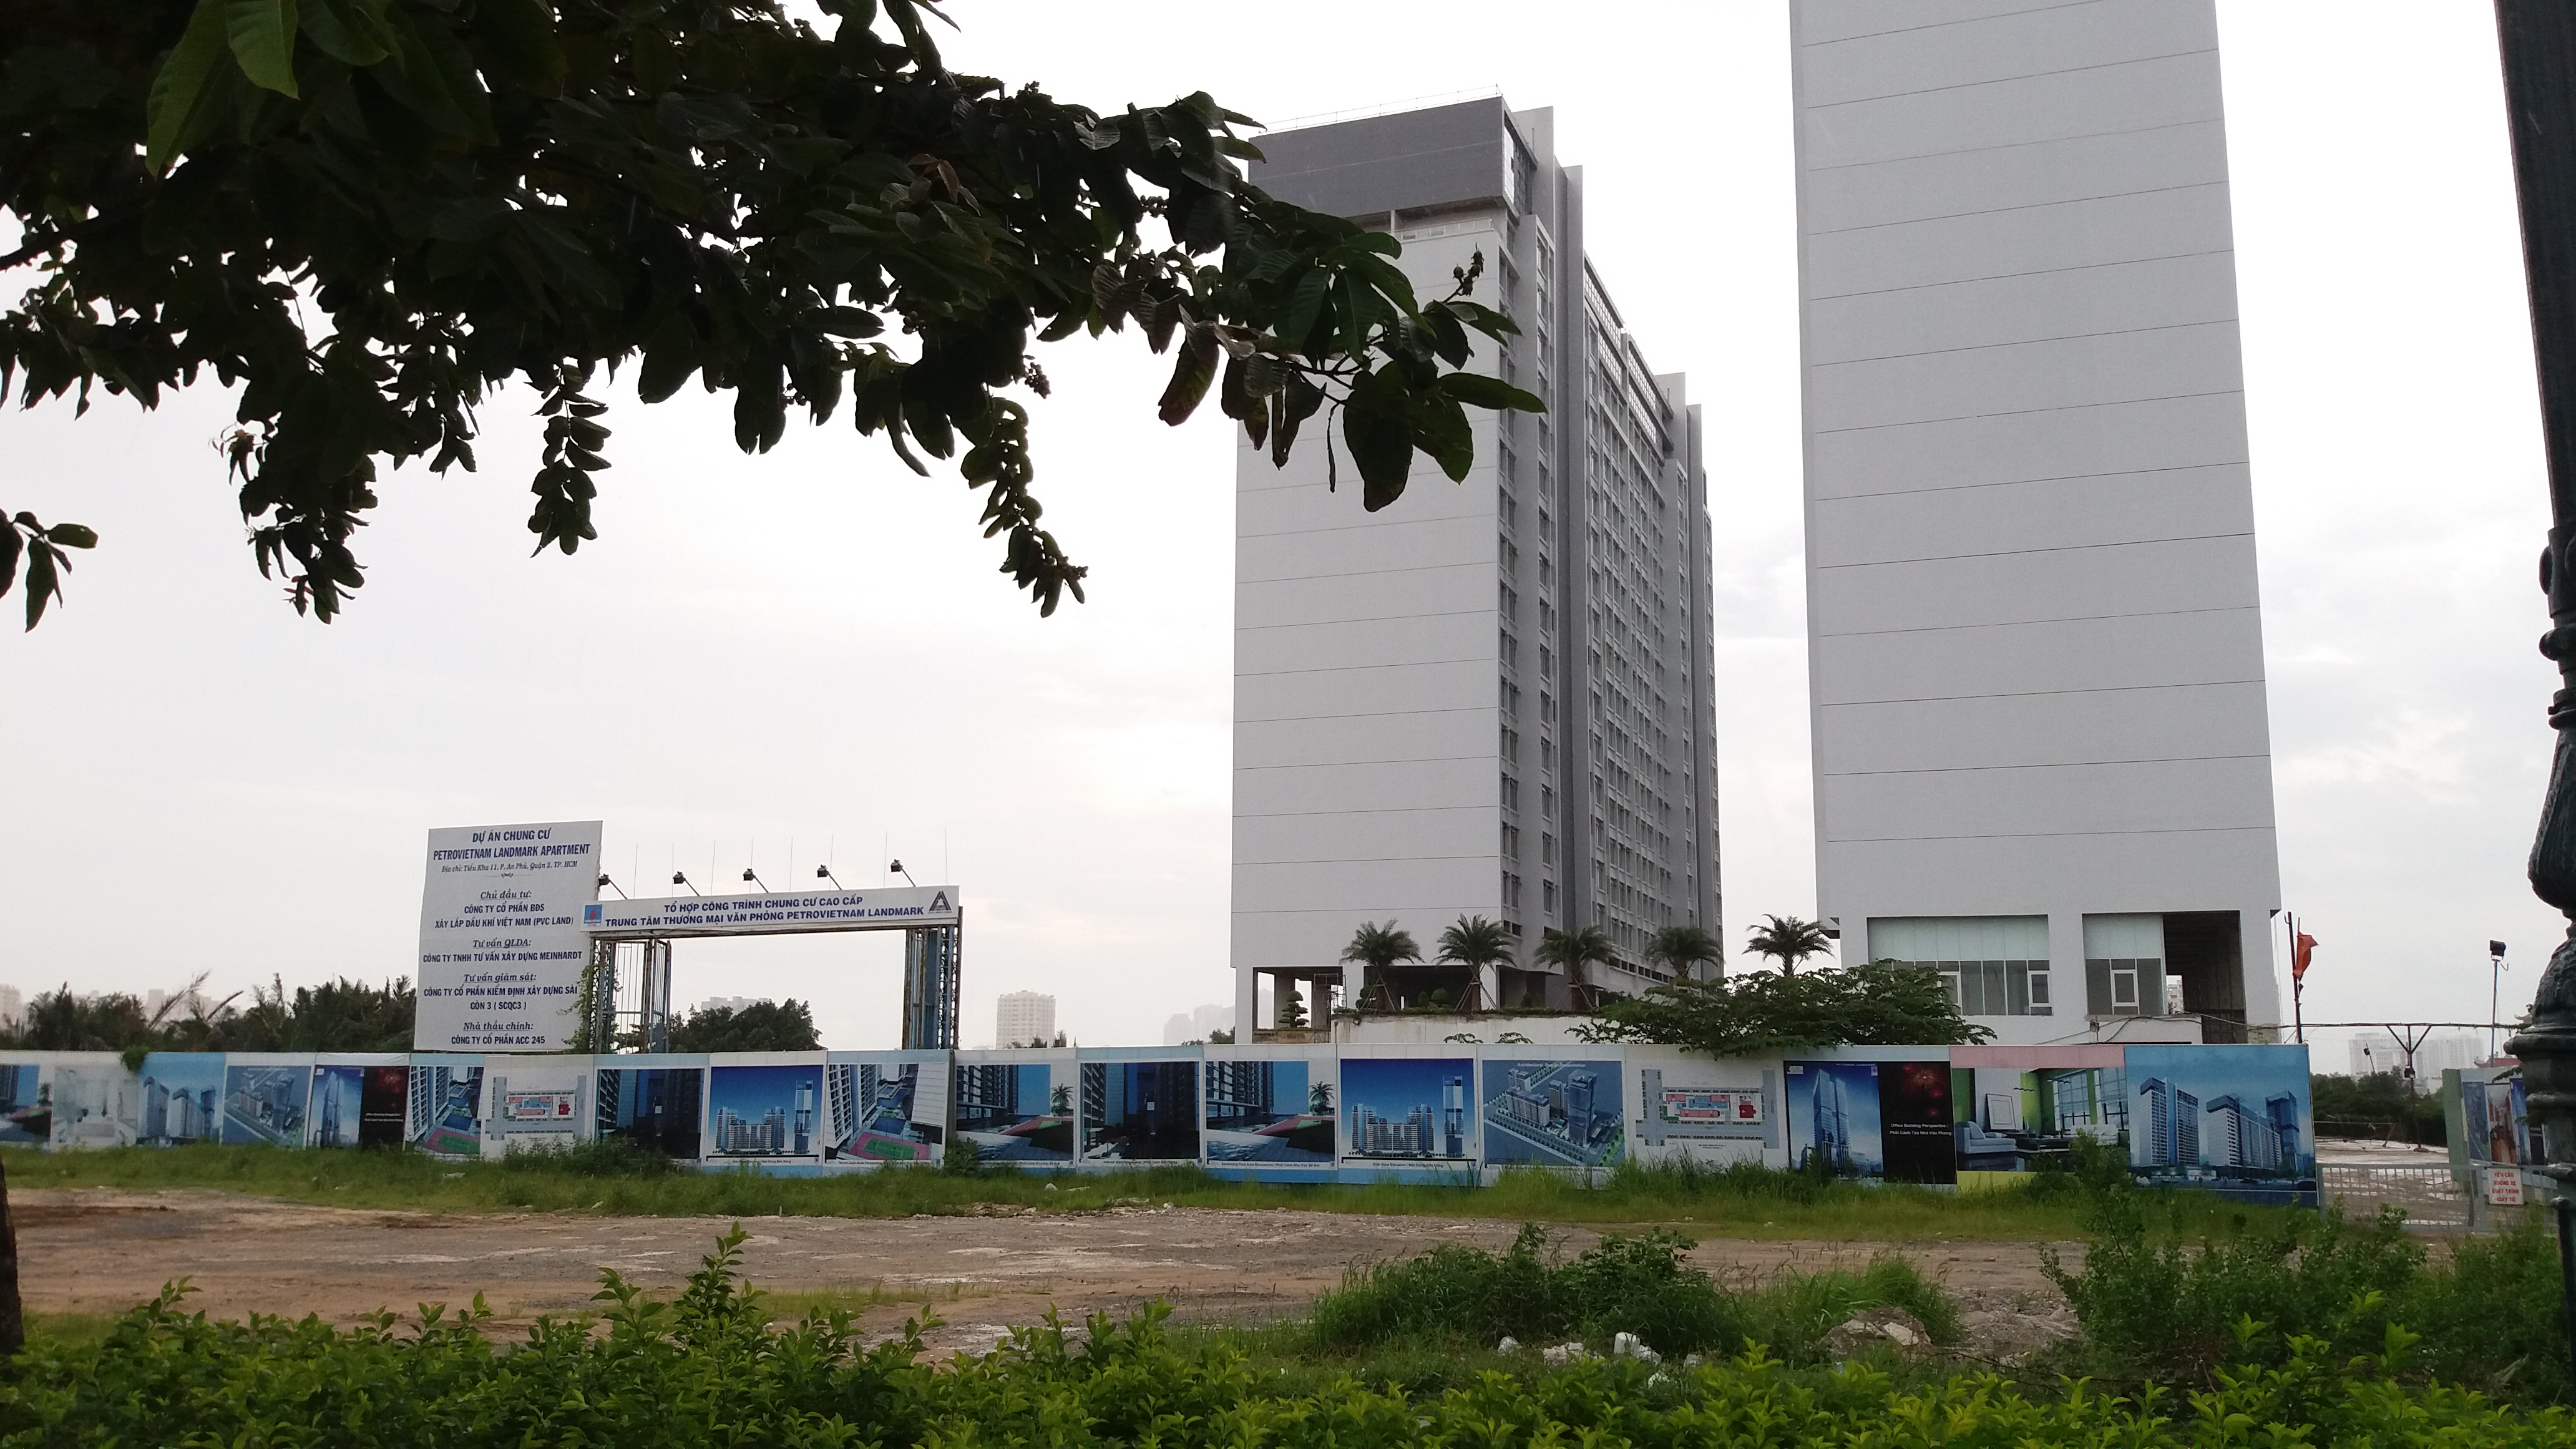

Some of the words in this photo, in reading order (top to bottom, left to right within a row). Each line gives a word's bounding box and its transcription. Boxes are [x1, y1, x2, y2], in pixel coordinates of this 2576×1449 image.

[472, 830, 485, 844] DỰ
[488, 830, 501, 842] ÁN
[503, 830, 534, 841] CHUNG
[537, 827, 550, 839] CƯ
[433, 848, 491, 860] PETROVIETNAM
[494, 846, 538, 858] LANDMARK
[540, 844, 590, 856] APARTMENT
[481, 890, 497, 899] Chủ
[499, 889, 517, 899] đầu
[464, 904, 483, 914] CÔNG
[496, 901, 507, 912] CỔ
[508, 902, 528, 912] PHẦN
[665, 901, 677, 912] TỔ
[680, 904, 699, 914] HỢP
[702, 901, 729, 911] CÔNG
[733, 900, 761, 910] TRÌNH
[765, 899, 800, 908] CHUNG
[804, 897, 817, 907] CƯ
[819, 897, 840, 906] CAO
[842, 894, 863, 905] CẤP
[435, 919, 449, 929] XÂY
[466, 916, 480, 927] DẦU
[482, 918, 494, 926] KHÍ
[497, 916, 512, 927] VIỆT
[515, 917, 531, 926] NAM
[534, 917, 550, 926] (PVC
[552, 917, 573, 925] LAND)
[606, 919, 637, 927] TRUNG
[641, 916, 661, 925] TÂM
[664, 914, 703, 925] THƯƠNG
[706, 915, 724, 925] MẠI
[728, 912, 747, 922] VĂN
[749, 910, 784, 921] PHÒNG
[787, 910, 865, 920] PETROVIETNAM
[868, 907, 924, 916] LANDMARK
[486, 937, 502, 947] vấn
[504, 939, 532, 949] QLDA:
[423, 954, 441, 962] CÔNG
[453, 954, 472, 962] TNHH
[474, 952, 484, 961] TƯ
[485, 951, 499, 961] VẤN
[502, 951, 516, 960] XÂY
[518, 952, 538, 961] DỰNG
[540, 951, 582, 960] MEINHARDT
[477, 971, 493, 981] vấn
[495, 973, 517, 983] giám
[424, 987, 442, 996] CÔNG
[454, 983, 464, 995] CỔ
[466, 985, 484, 995] PHẦN
[487, 983, 505, 995] KIỂM
[507, 985, 524, 997] ĐỊNH
[527, 985, 541, 995] XÂY
[544, 986, 563, 995] DỰNG
[565, 984, 577, 994] SÀI
[471, 1000, 485, 1010] GÒN
[499, 1002, 522, 1010] SCQC3
[483, 1020, 504, 1030] thầu
[452, 1035, 470, 1045] CÔNG
[483, 1033, 492, 1044] CỔ
[494, 1033, 514, 1043] PHẦN
